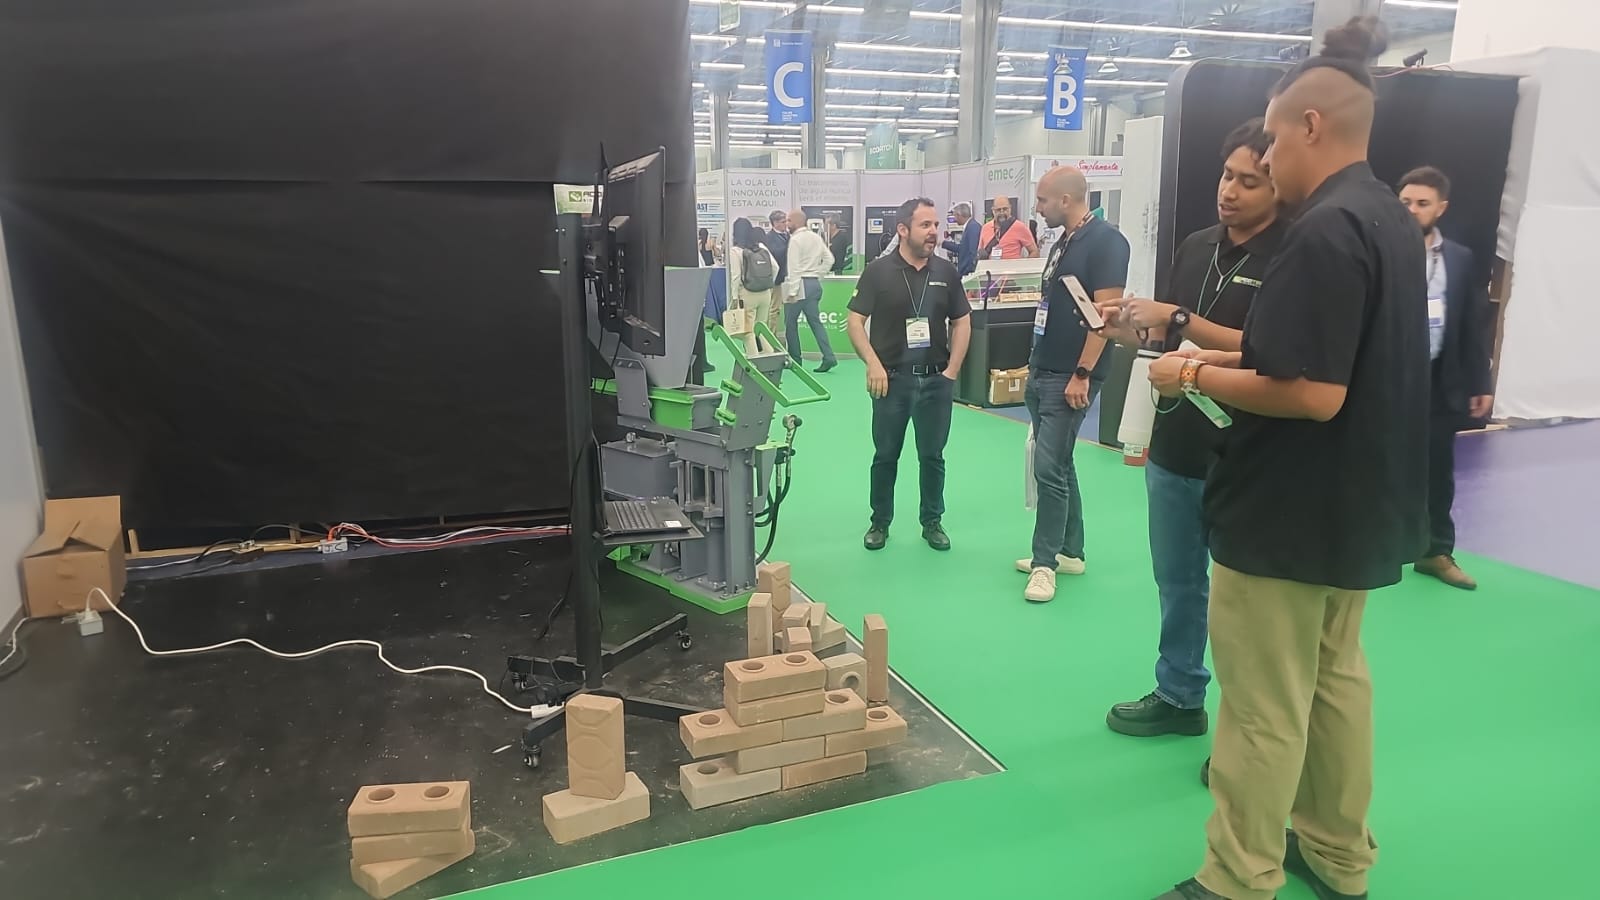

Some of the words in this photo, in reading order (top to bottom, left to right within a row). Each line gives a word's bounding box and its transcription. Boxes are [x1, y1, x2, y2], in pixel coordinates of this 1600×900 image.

[774, 61, 804, 107] C
[1052, 75, 1077, 116] B
[766, 179, 776, 187] DE
[988, 167, 1014, 181] emec
